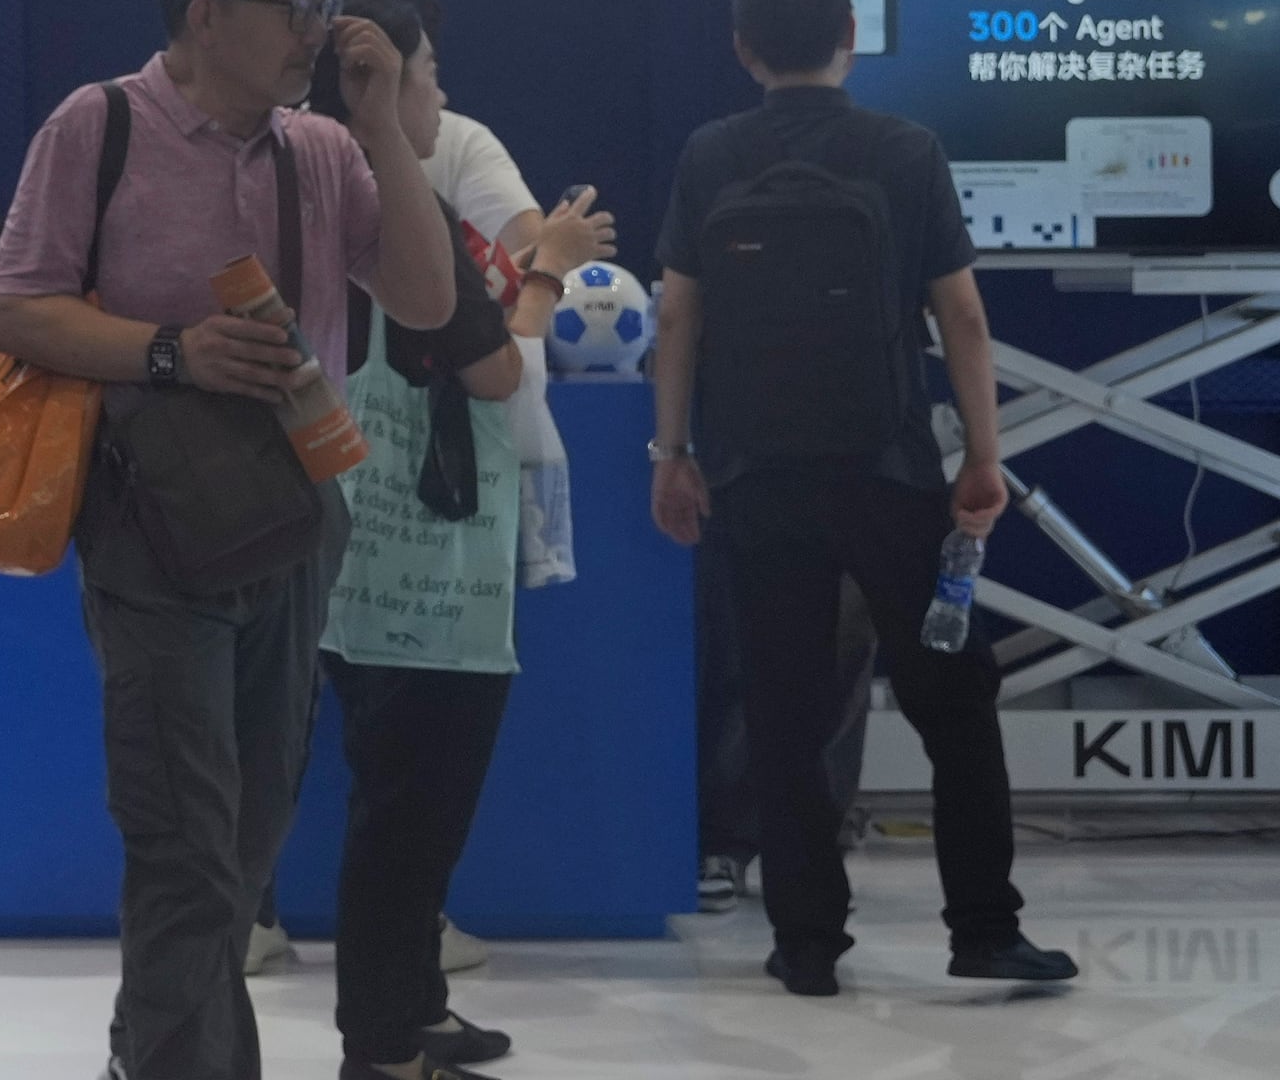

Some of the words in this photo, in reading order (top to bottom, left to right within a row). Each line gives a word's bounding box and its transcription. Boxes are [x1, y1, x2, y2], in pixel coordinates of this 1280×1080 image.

[968, 11, 1069, 43] 300个
[1076, 14, 1164, 46] Agent
[968, 50, 1206, 81] 帮你解决复杂任务
[478, 470, 500, 489] ay
[416, 527, 452, 550] day
[399, 572, 412, 591] &
[416, 574, 450, 599] day
[455, 576, 468, 595] &
[470, 578, 505, 600] day
[330, 584, 357, 602] ay
[357, 585, 370, 603] &
[375, 589, 411, 616] day
[414, 600, 428, 617] &
[431, 601, 464, 623] day
[1073, 719, 1256, 779] KIMI
